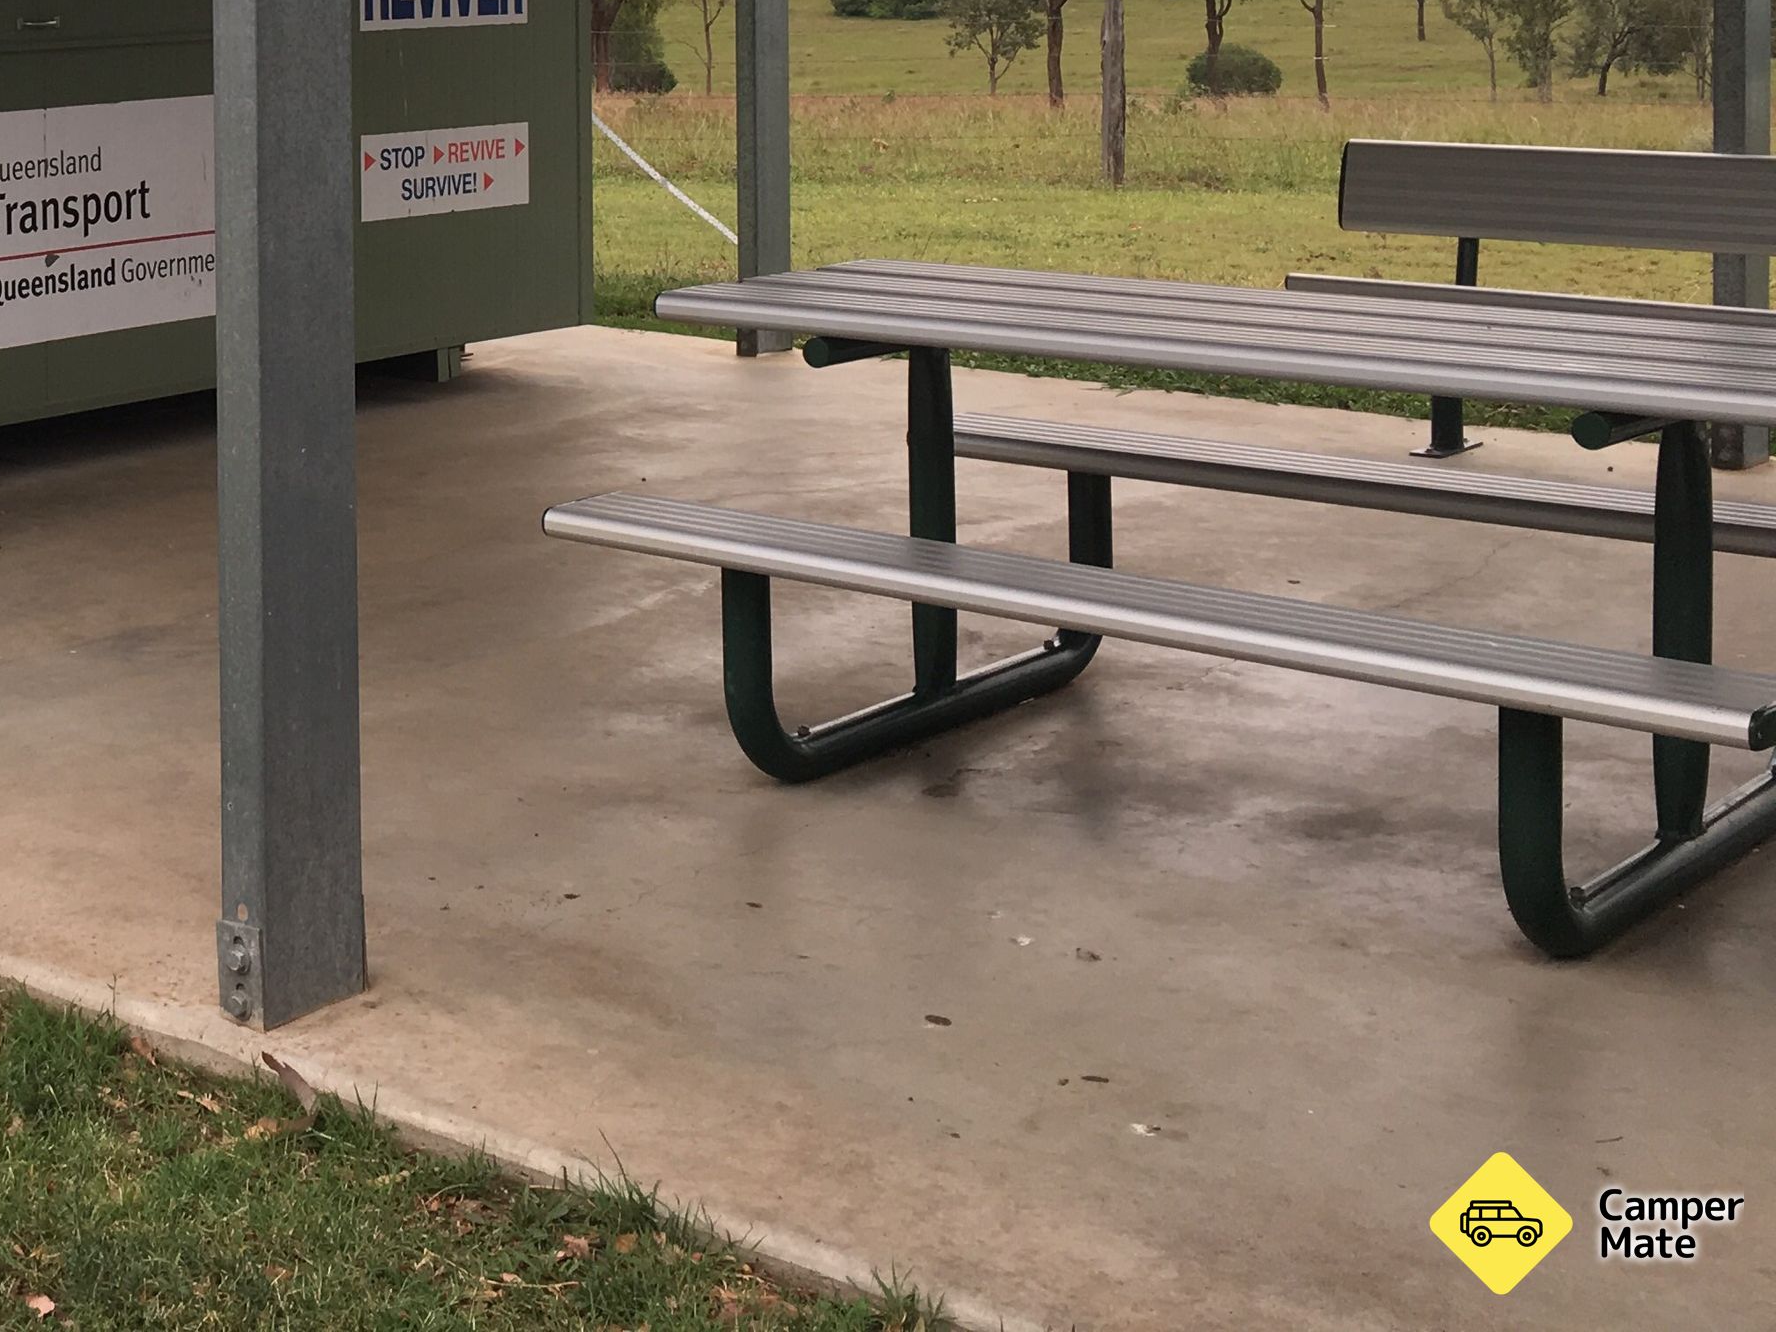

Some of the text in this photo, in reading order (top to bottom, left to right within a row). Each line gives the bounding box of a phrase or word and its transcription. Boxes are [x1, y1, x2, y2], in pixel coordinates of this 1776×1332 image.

[380, 138, 506, 171] STOP REVIVE
[401, 172, 477, 201] SURVIVE!
